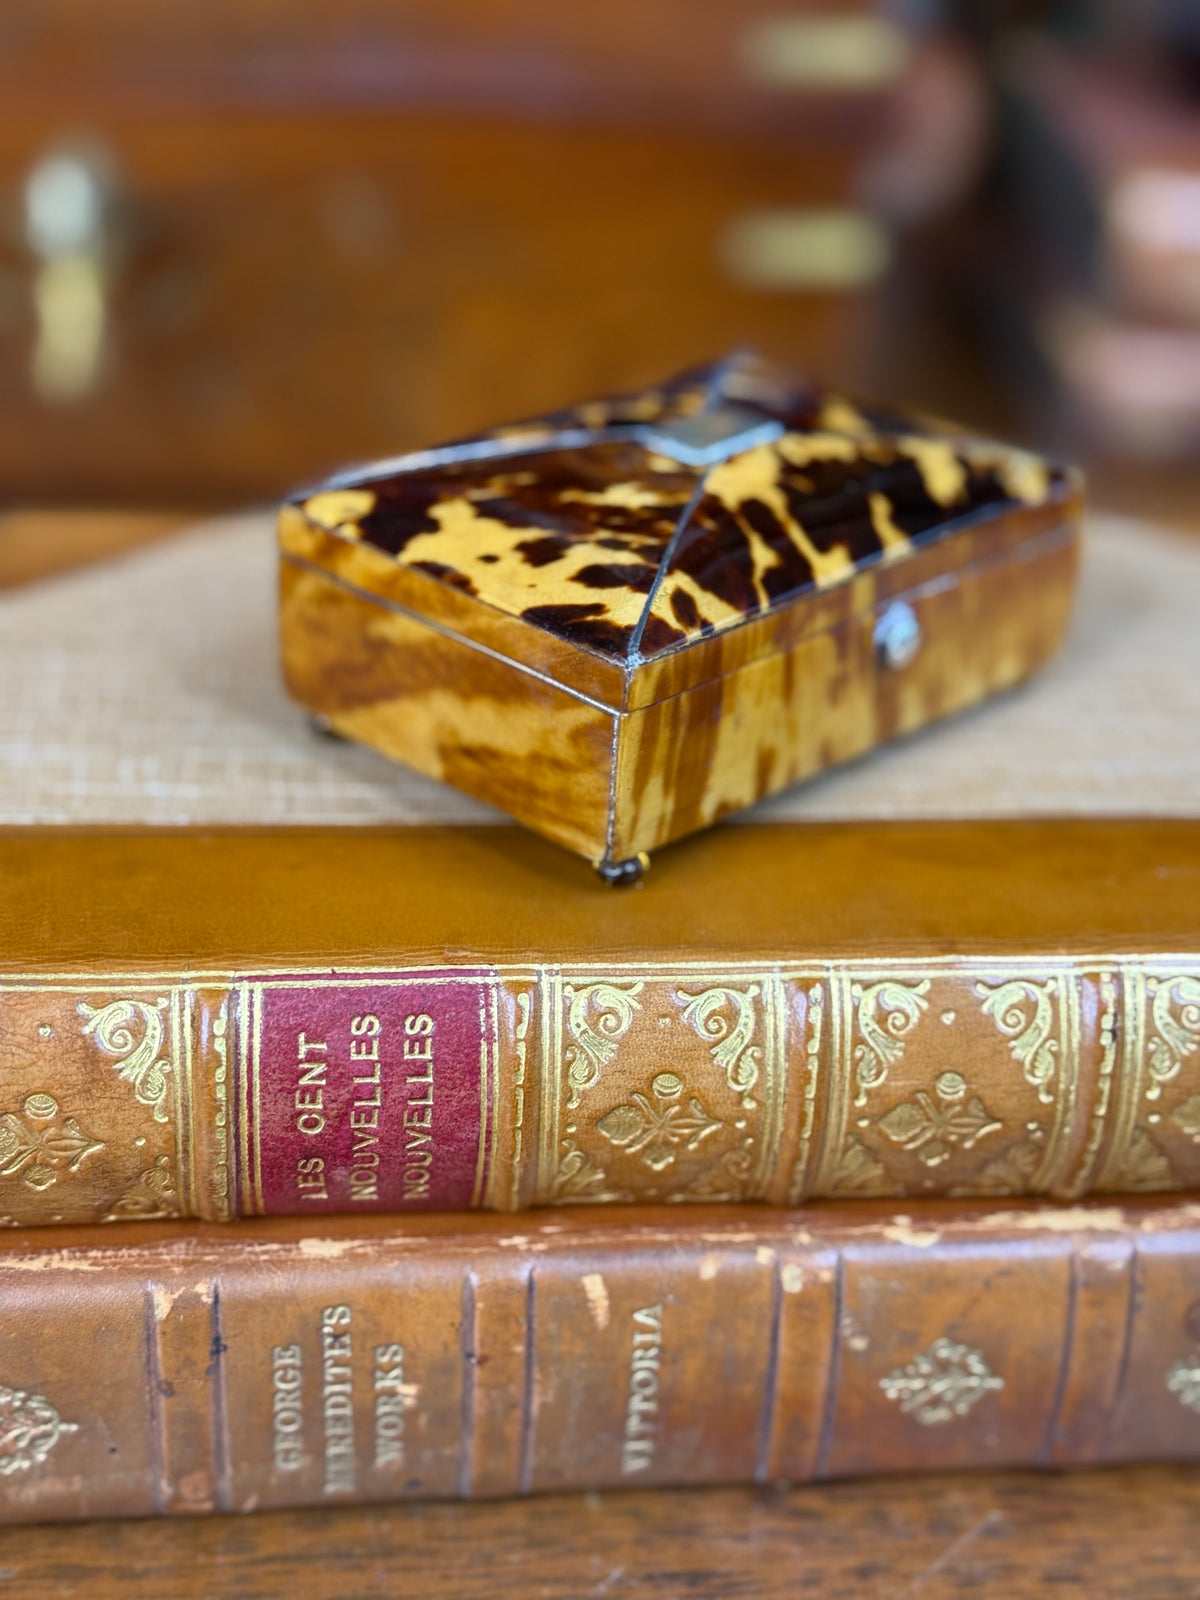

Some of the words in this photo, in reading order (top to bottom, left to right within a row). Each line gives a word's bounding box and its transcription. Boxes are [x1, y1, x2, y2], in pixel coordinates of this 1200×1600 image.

[295, 1032, 327, 1135] CENT
[350, 1014, 381, 1200] NOUVELLES
[402, 1013, 434, 1199] NOUVELLES
[298, 1157, 328, 1200] LES
[273, 1344, 302, 1471] GEORGE
[373, 1344, 404, 1468] WORKS
